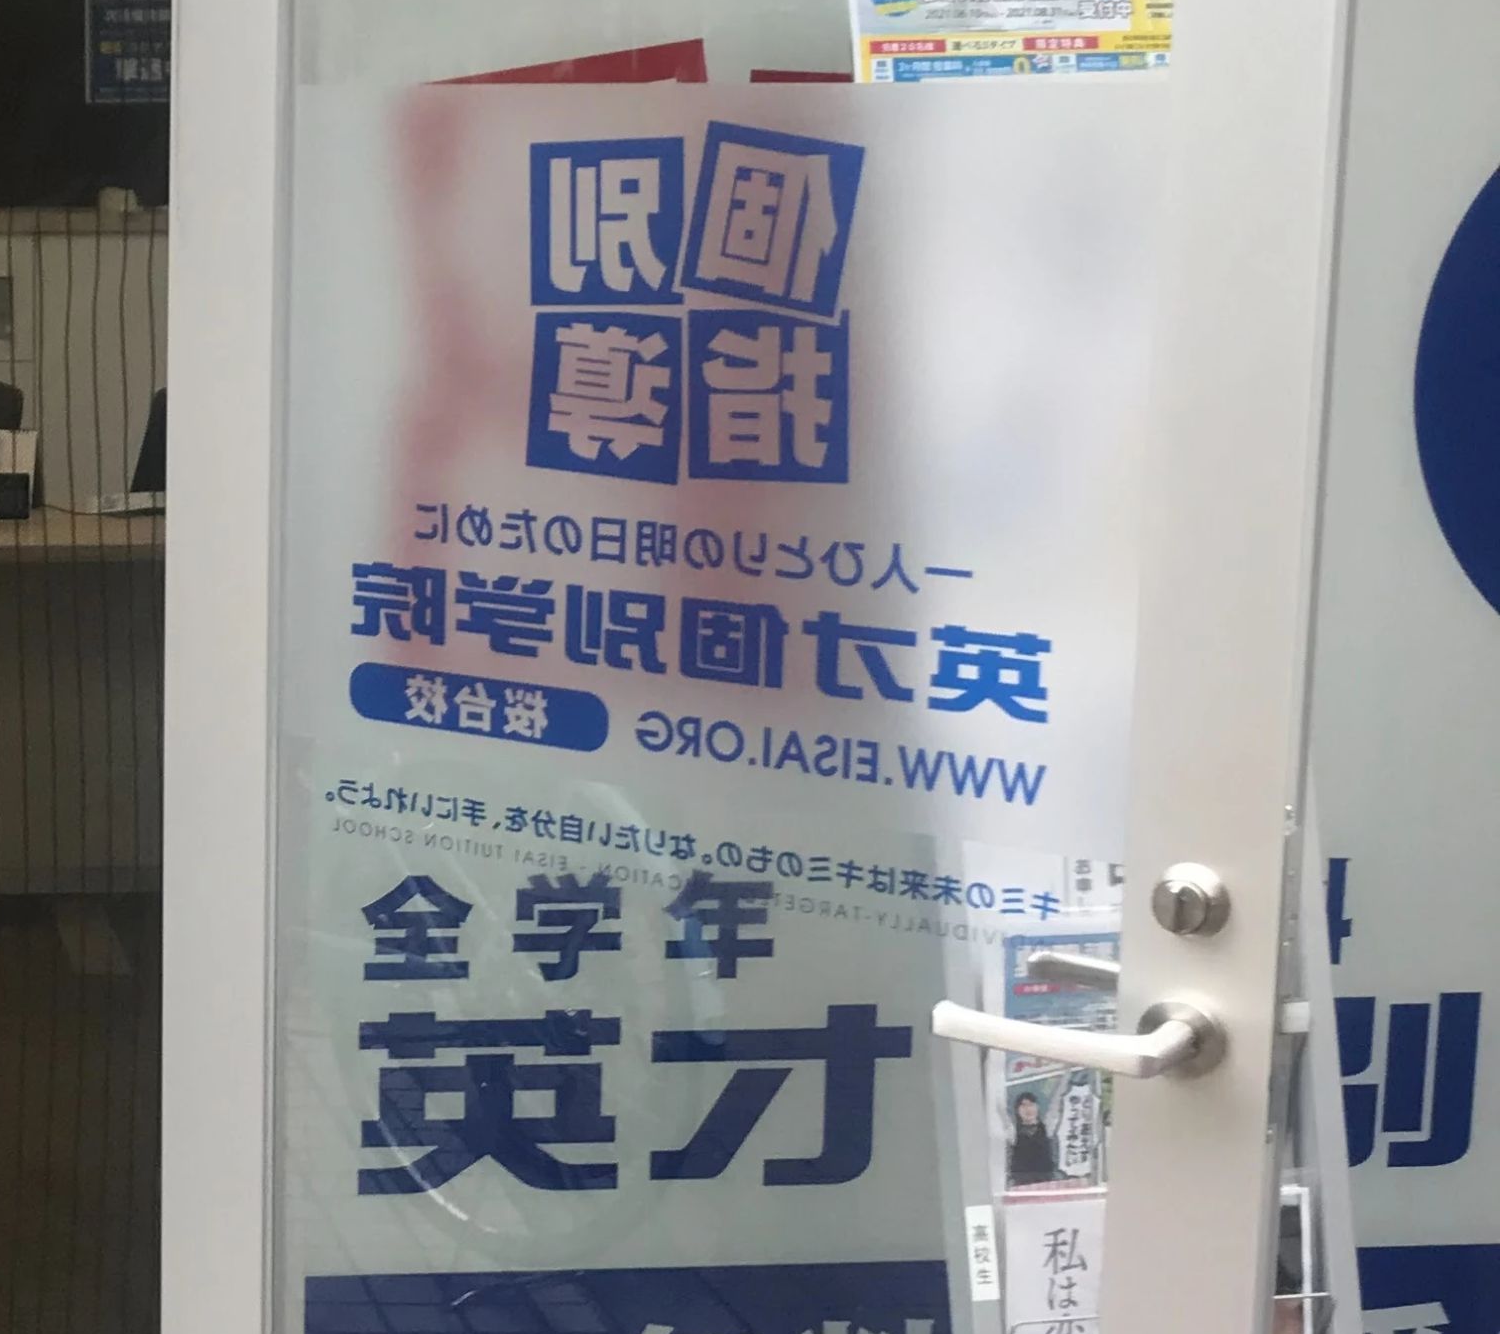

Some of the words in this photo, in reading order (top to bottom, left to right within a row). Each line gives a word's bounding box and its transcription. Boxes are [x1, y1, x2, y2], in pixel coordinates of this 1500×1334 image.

[360, 872, 776, 984] 全学年
[357, 1003, 914, 1197] 英才
[971, 1224, 993, 1285] 高校生
